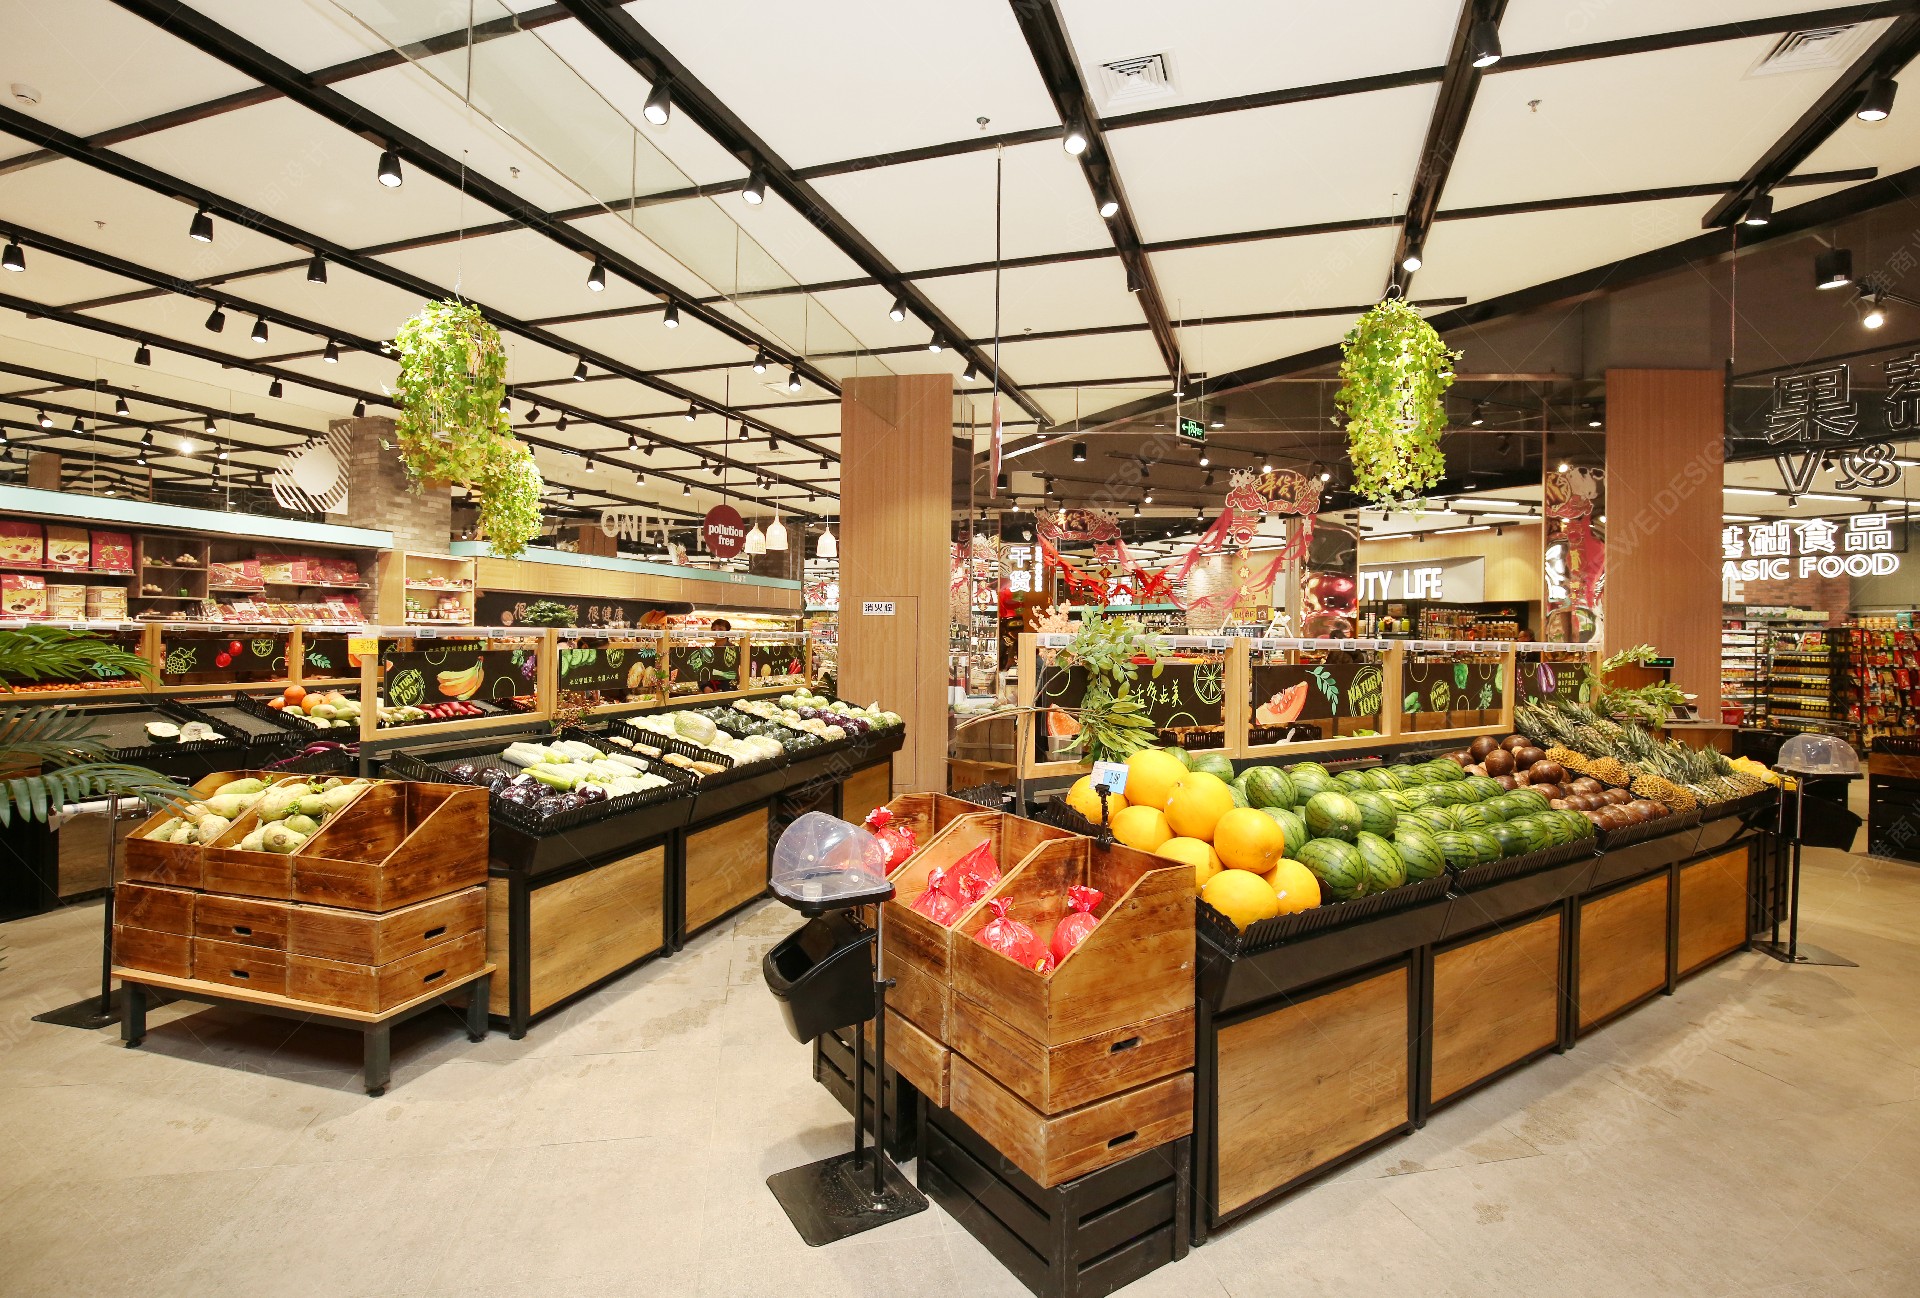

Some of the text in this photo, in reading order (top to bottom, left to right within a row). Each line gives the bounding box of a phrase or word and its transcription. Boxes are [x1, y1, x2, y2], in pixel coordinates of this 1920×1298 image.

[1256, 472, 1304, 500] 年货节
[601, 509, 674, 546] ONLY
[708, 524, 744, 538] pollution
[718, 535, 735, 547] free
[1008, 546, 1032, 592] 干货
[1799, 553, 1900, 579] FOOD
[1403, 567, 1443, 600] LIFE
[588, 605, 625, 622] 很健康
[865, 603, 892, 612] 消火栓
[389, 668, 422, 699] NATURAL
[1347, 669, 1382, 702] NATURA
[1359, 693, 1382, 716] 100
